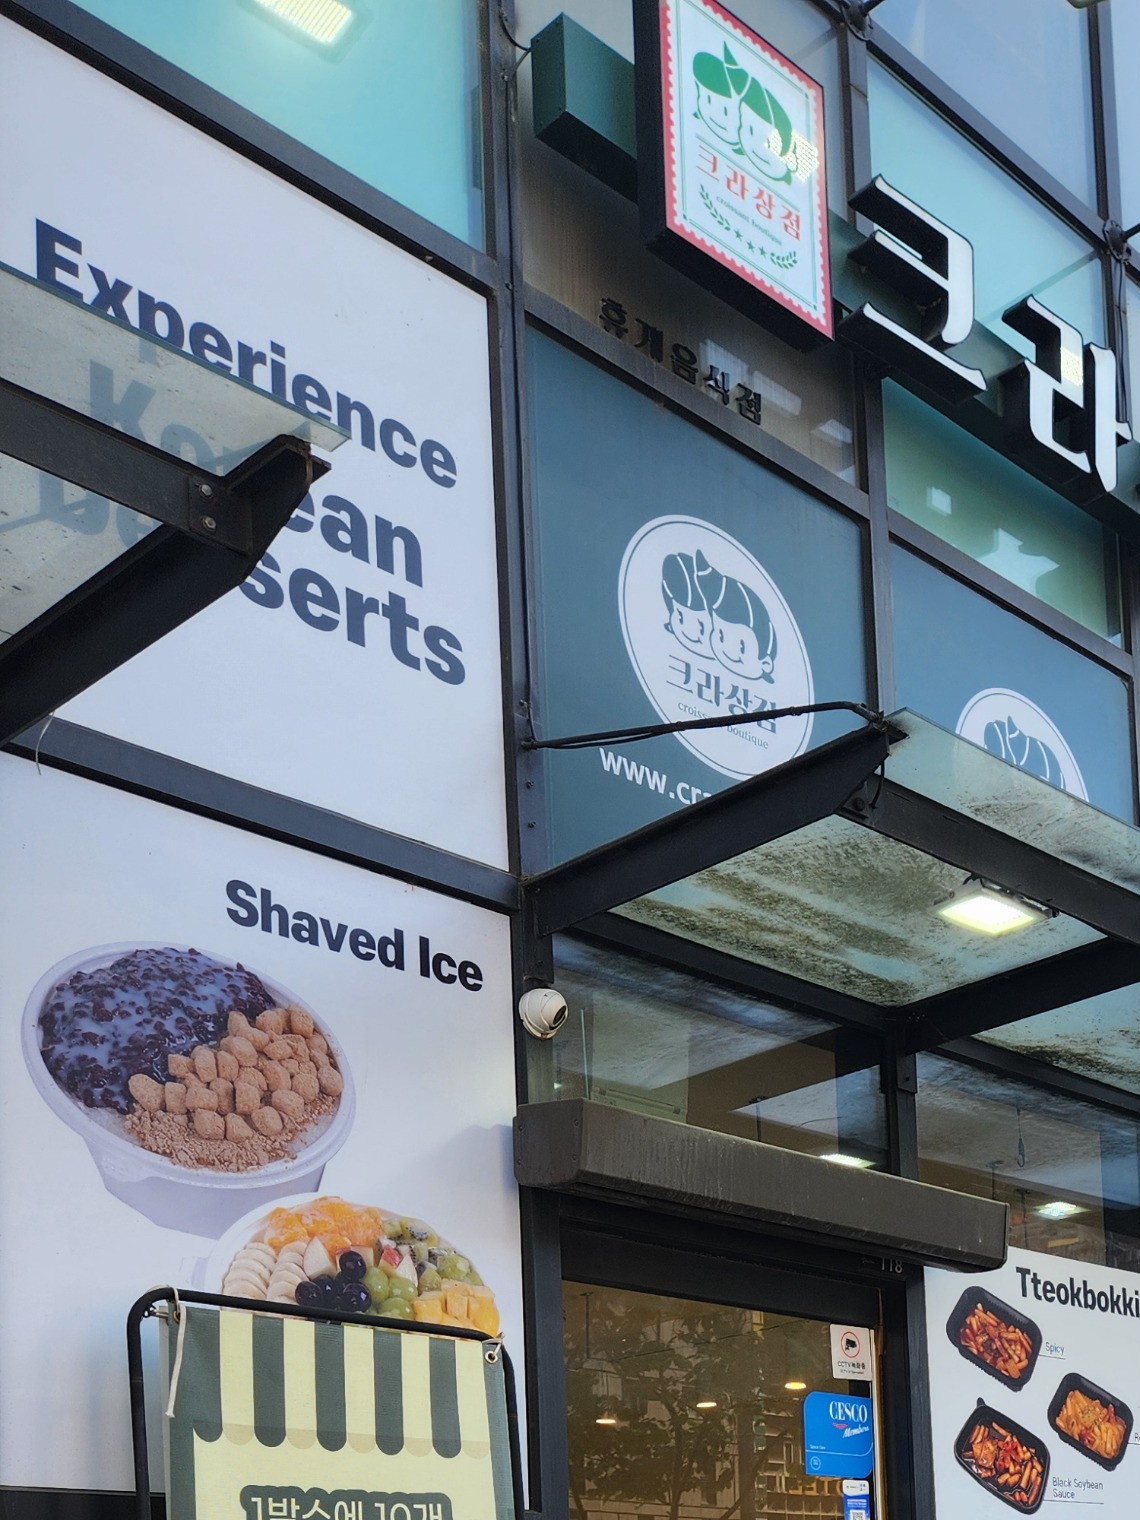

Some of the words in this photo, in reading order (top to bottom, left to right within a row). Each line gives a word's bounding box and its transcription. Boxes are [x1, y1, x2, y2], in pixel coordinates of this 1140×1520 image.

[697, 144, 801, 241] 크라상점
[36, 218, 457, 489] Experience
[599, 297, 762, 426] 휴게음식점
[666, 654, 777, 734] 크라상점
[226, 879, 404, 972] Shaved
[418, 937, 484, 992] Ice
[881, 1257, 903, 1274] 118
[1016, 1267, 1140, 1319] Tteokbokki
[1045, 1341, 1065, 1355] Spicy
[829, 1400, 868, 1424] CESCO
[1052, 1476, 1072, 1488] Black
[1073, 1477, 1103, 1491] Soybean
[1052, 1488, 1076, 1500] Sauce
